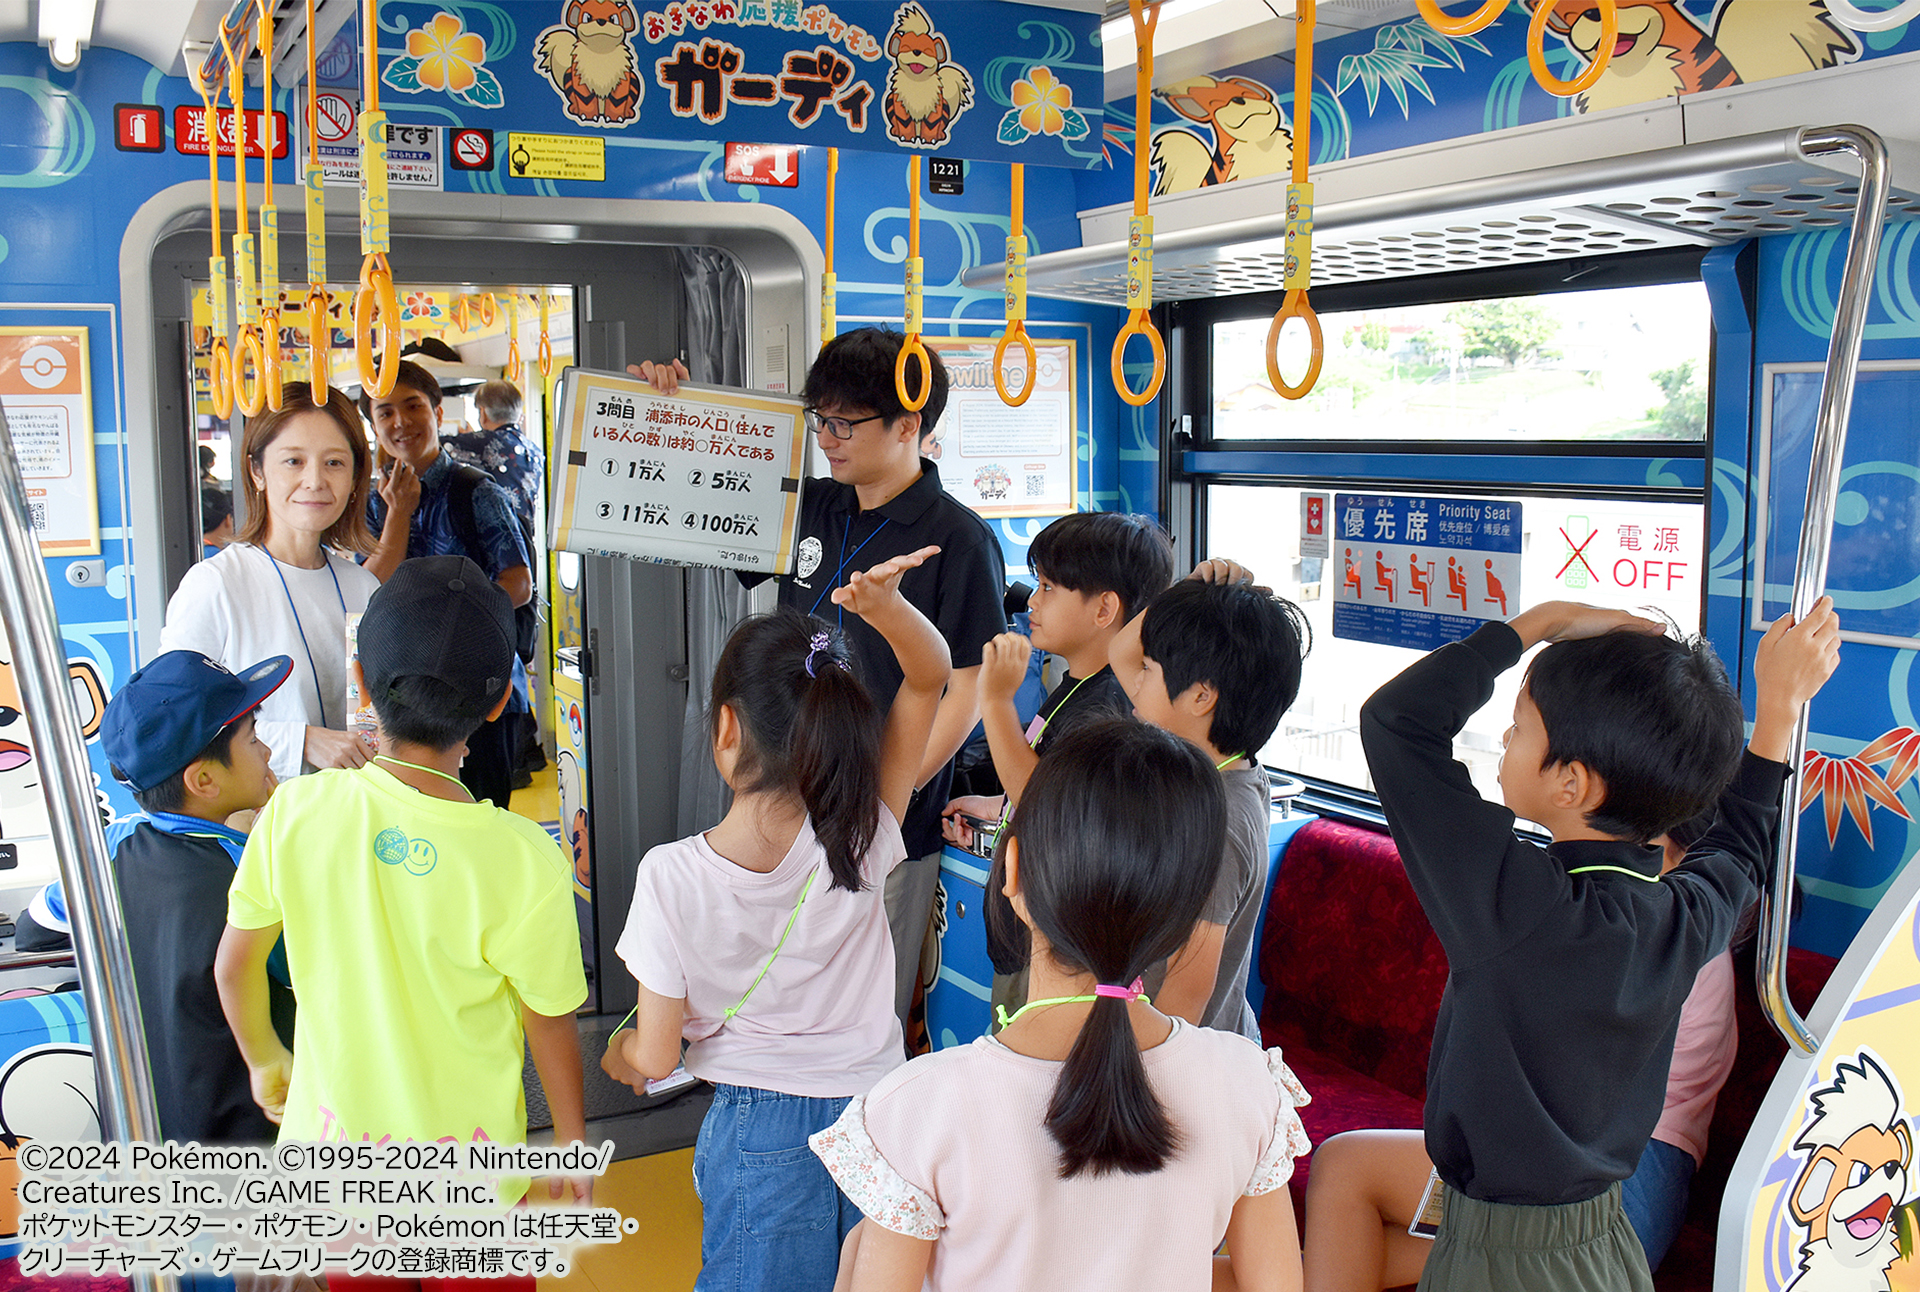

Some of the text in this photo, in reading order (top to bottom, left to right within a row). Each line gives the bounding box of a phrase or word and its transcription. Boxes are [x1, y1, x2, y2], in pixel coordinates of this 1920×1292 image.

[647, 0, 879, 57] おきなわ応援ポケモン
[661, 41, 872, 128] ガーディ
[183, 143, 200, 151] FIRE
[735, 144, 760, 156] SOS
[932, 162, 959, 176] 1221
[596, 402, 775, 438] 3問目 浦添市の人口(住んで
[628, 461, 666, 482] 1万人
[711, 472, 751, 493] 5万人
[622, 504, 669, 526] 11万人
[1439, 503, 1511, 521] Priority Seat
[701, 513, 759, 537] 100万人
[1343, 506, 1429, 542] 優先席
[1617, 524, 1680, 553] 電源
[1613, 558, 1688, 591] OFF
